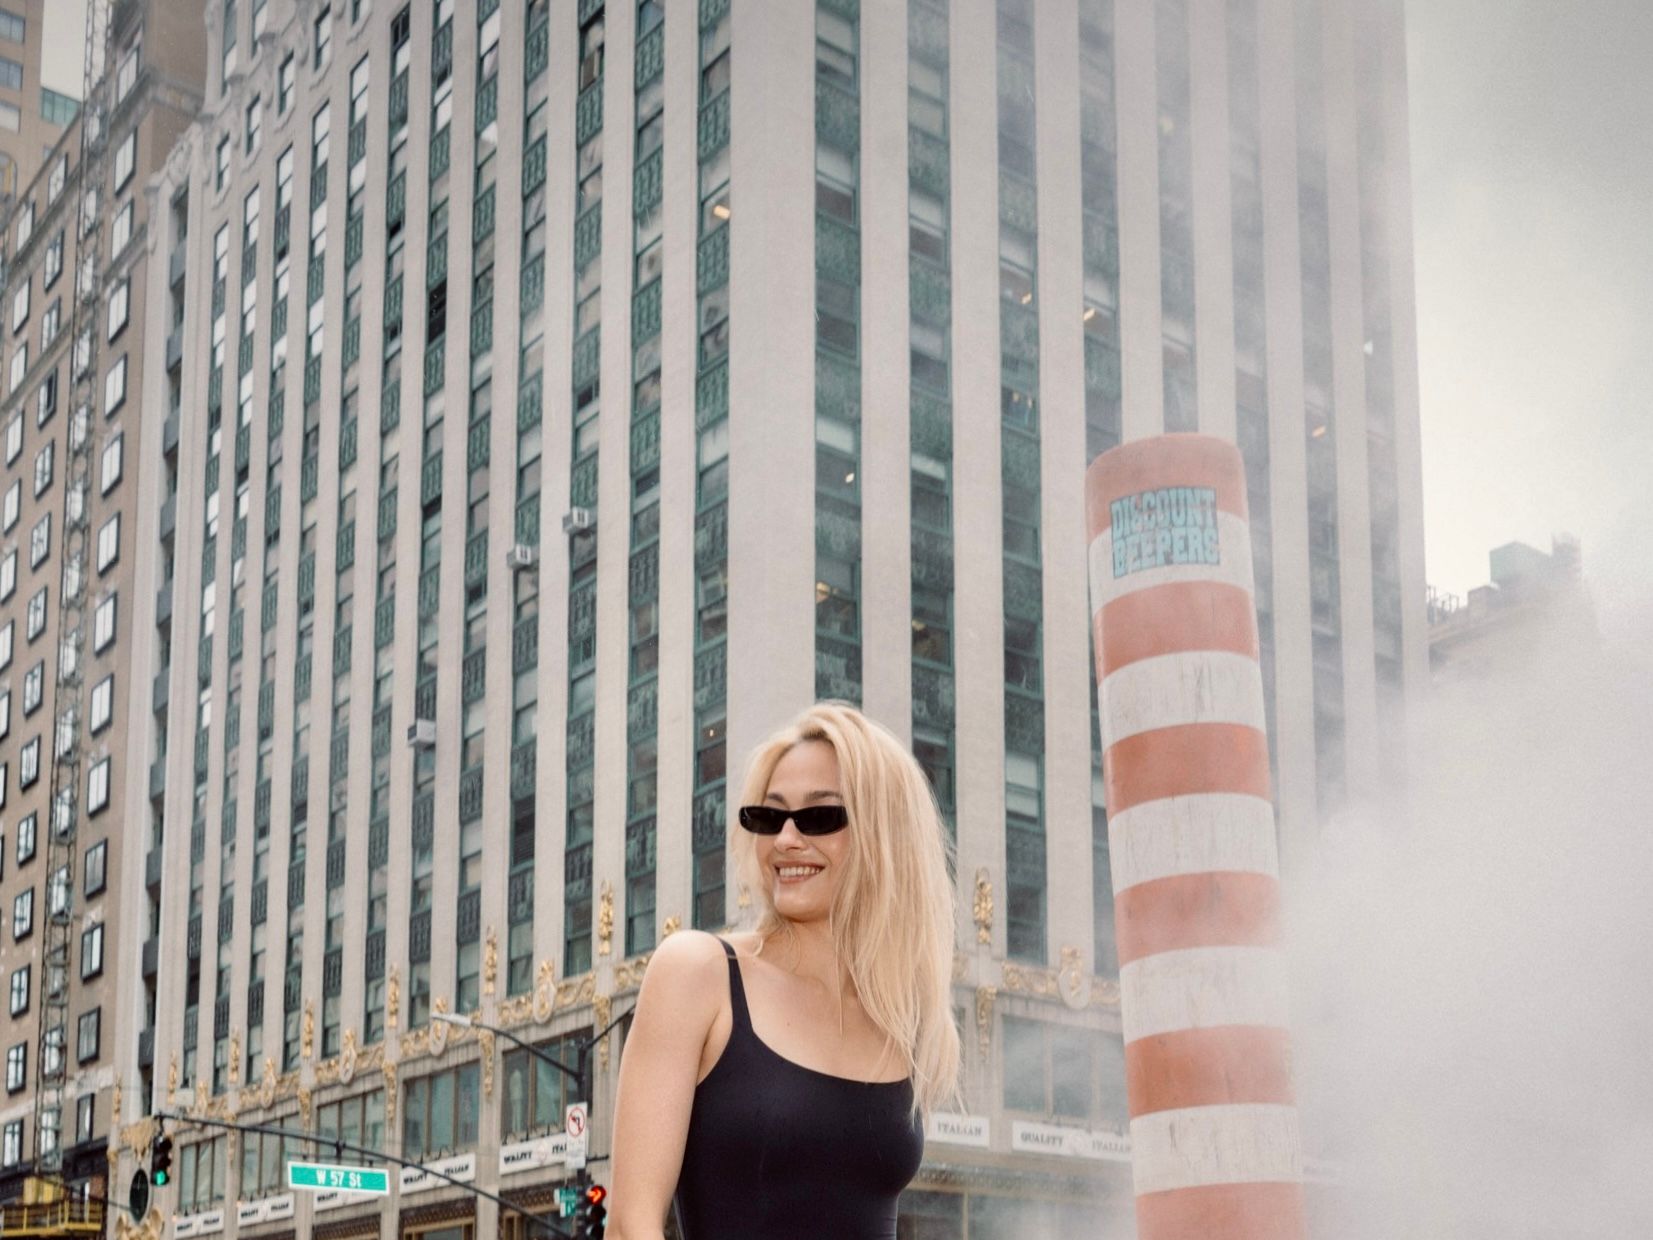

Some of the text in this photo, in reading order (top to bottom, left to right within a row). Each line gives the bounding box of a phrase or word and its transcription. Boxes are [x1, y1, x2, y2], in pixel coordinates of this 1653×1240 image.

[1111, 486, 1217, 538] DISCOUNT
[1112, 527, 1220, 579] BEEPERS
[938, 1121, 982, 1137] ITALIAN
[1020, 1131, 1064, 1149] QUALITY
[315, 1168, 362, 1188] W 57 St
